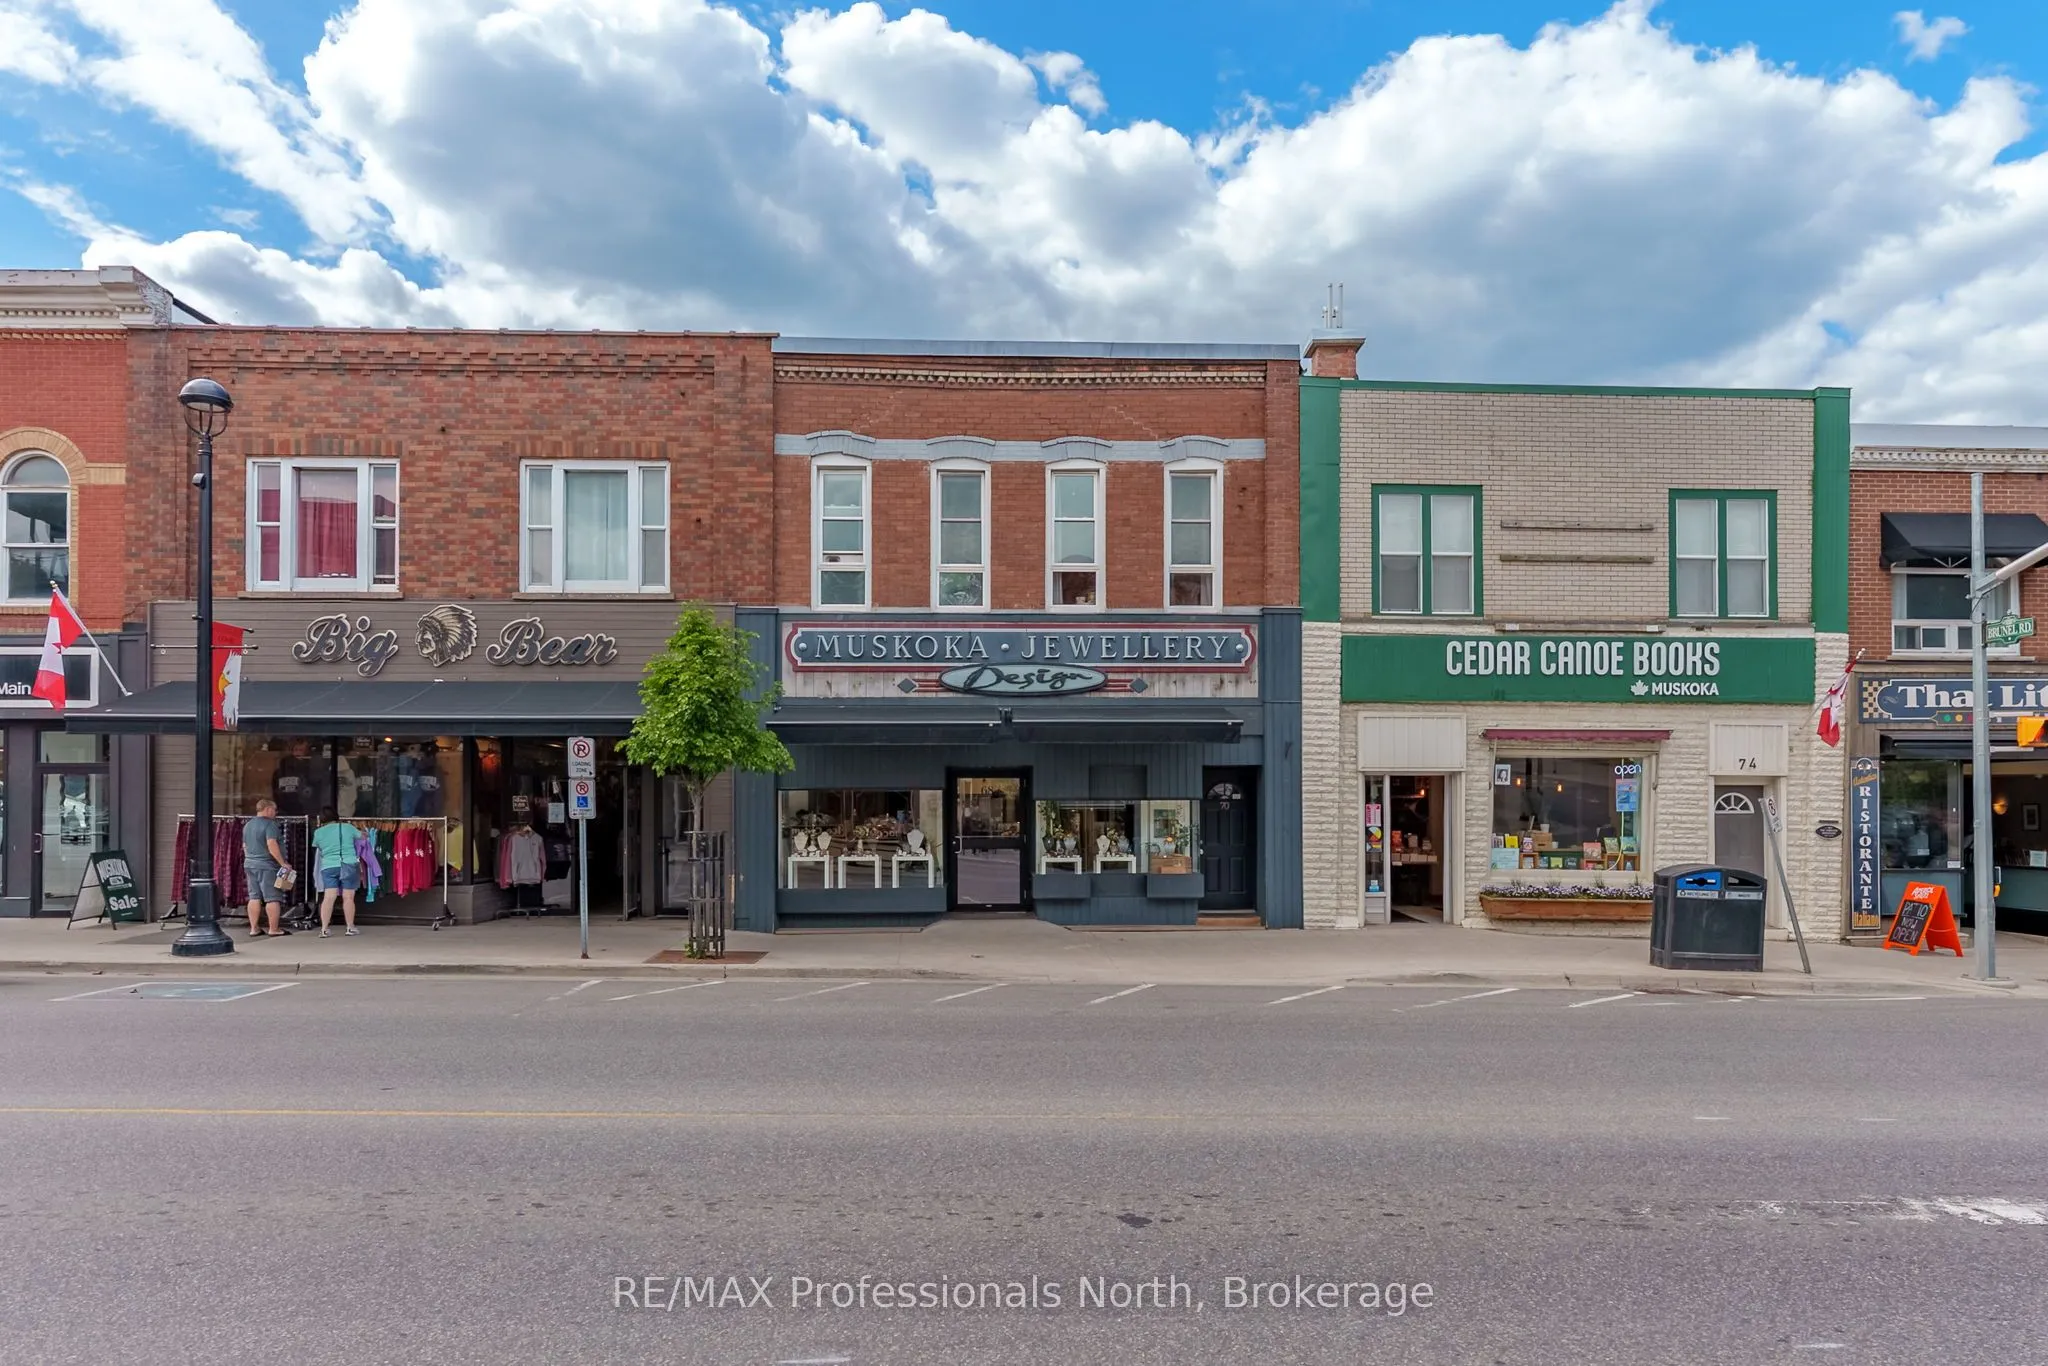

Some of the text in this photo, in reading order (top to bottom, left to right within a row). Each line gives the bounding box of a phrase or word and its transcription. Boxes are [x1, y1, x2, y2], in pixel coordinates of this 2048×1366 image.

[1988, 623, 2019, 638] BRUNEL
[292, 613, 617, 677] Big Bear
[814, 634, 1230, 660] MUSKOKA JEWELLERY
[1445, 640, 1720, 677] CEDAR CANOE BOOKS
[962, 663, 1092, 693] Design
[1651, 682, 1720, 696] MUSKOKA
[1898, 684, 1992, 708] Tha
[1614, 764, 1642, 777] open
[1738, 757, 1757, 770] 74
[1859, 785, 1873, 909] RISTORANTE
[109, 894, 139, 911] Sale
[1901, 917, 1919, 929] NOW
[1892, 927, 1920, 941] OPEN
